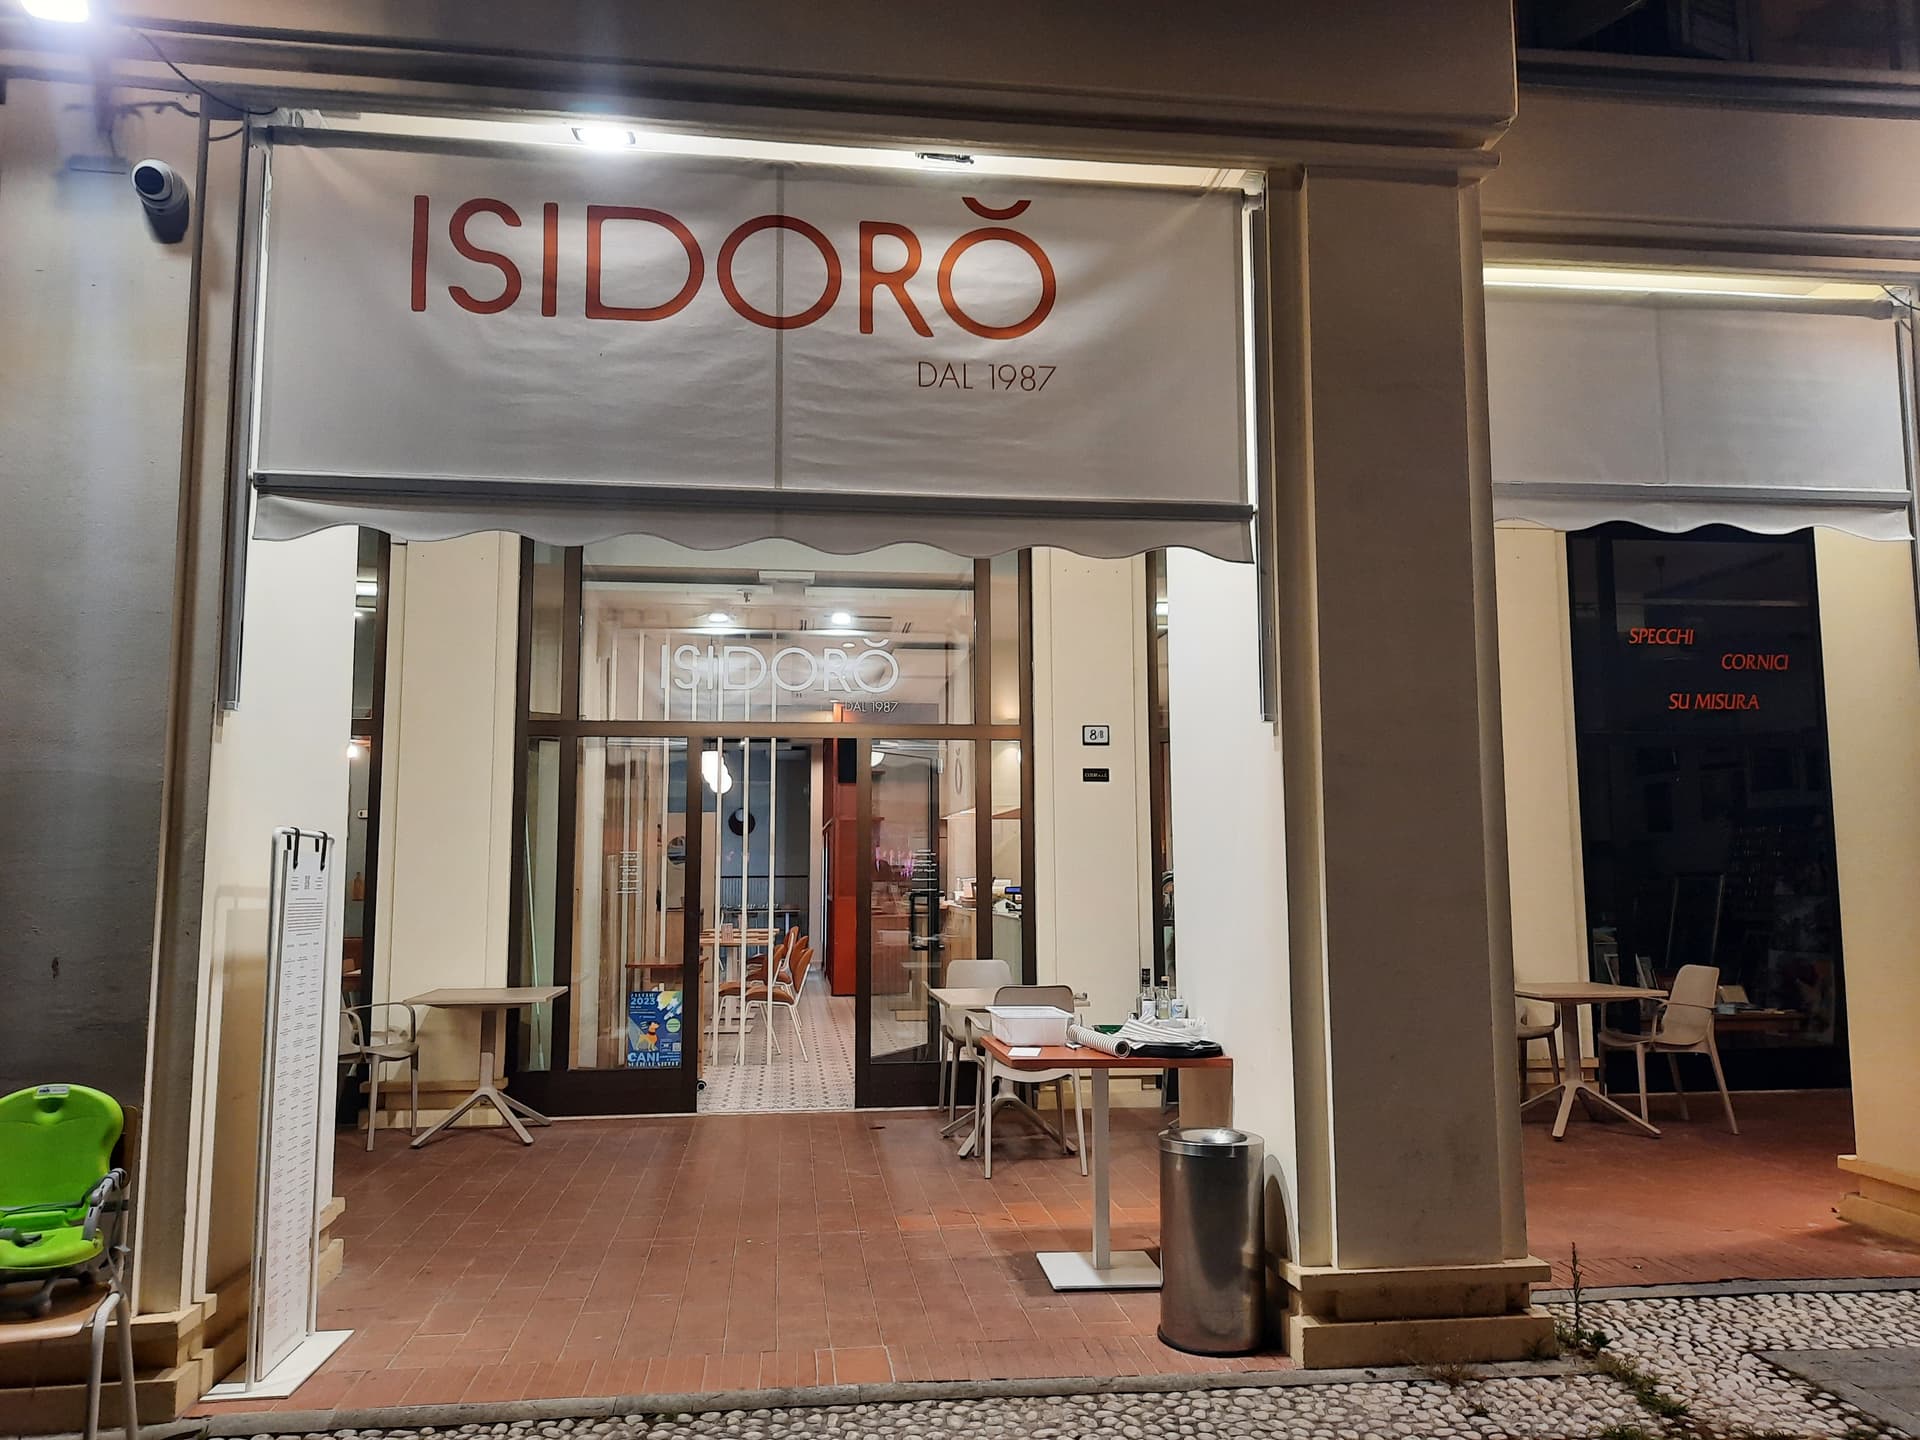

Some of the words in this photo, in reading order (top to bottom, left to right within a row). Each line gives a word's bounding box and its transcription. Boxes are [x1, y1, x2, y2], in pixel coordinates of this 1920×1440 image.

[917, 360, 974, 390] DAL
[988, 362, 1057, 392] 1987
[1628, 627, 1695, 645] SPECCHI
[1721, 653, 1789, 671] CORNICI
[845, 701, 867, 712] DAL
[871, 702, 898, 712] 1987
[1667, 693, 1690, 710] SU
[1694, 693, 1760, 710] MISURA
[630, 997, 656, 1006] 2023
[627, 1052, 660, 1063] CANI
